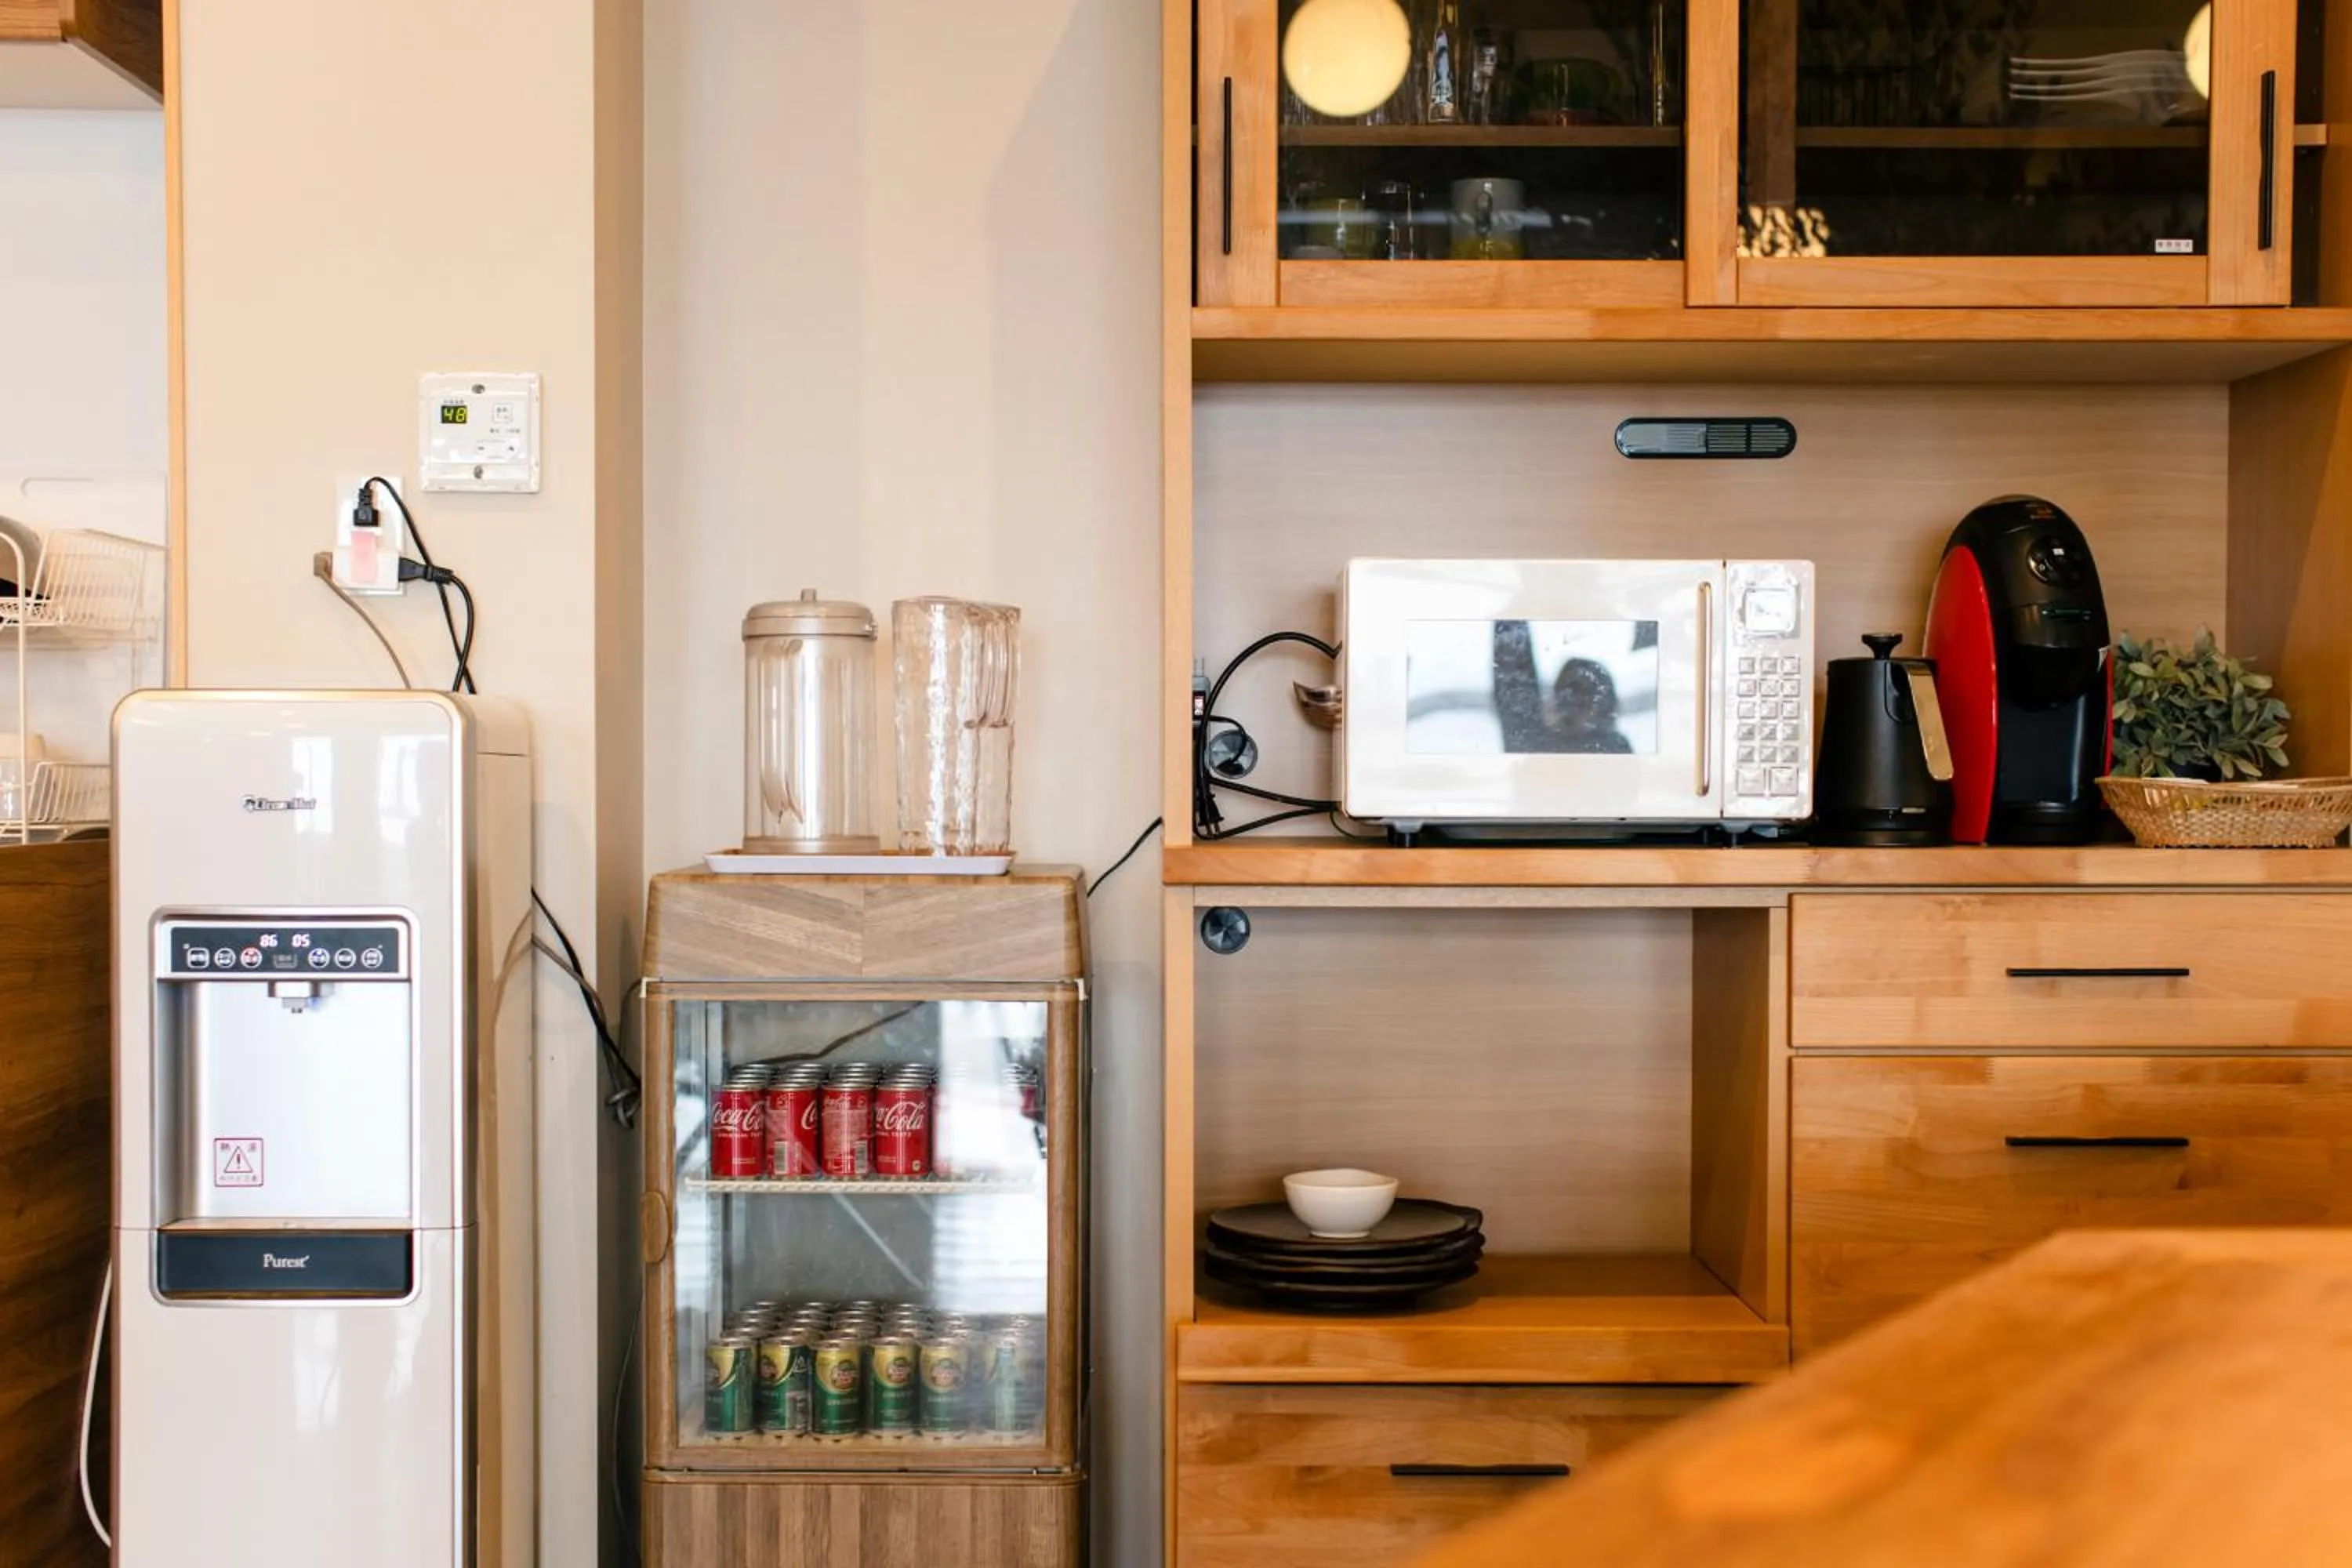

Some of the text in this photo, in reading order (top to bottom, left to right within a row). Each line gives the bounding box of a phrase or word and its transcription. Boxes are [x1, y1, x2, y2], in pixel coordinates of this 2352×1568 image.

[444, 407, 466, 423] 48
[260, 934, 310, 947] 86 05
[263, 1254, 310, 1268] Purest
